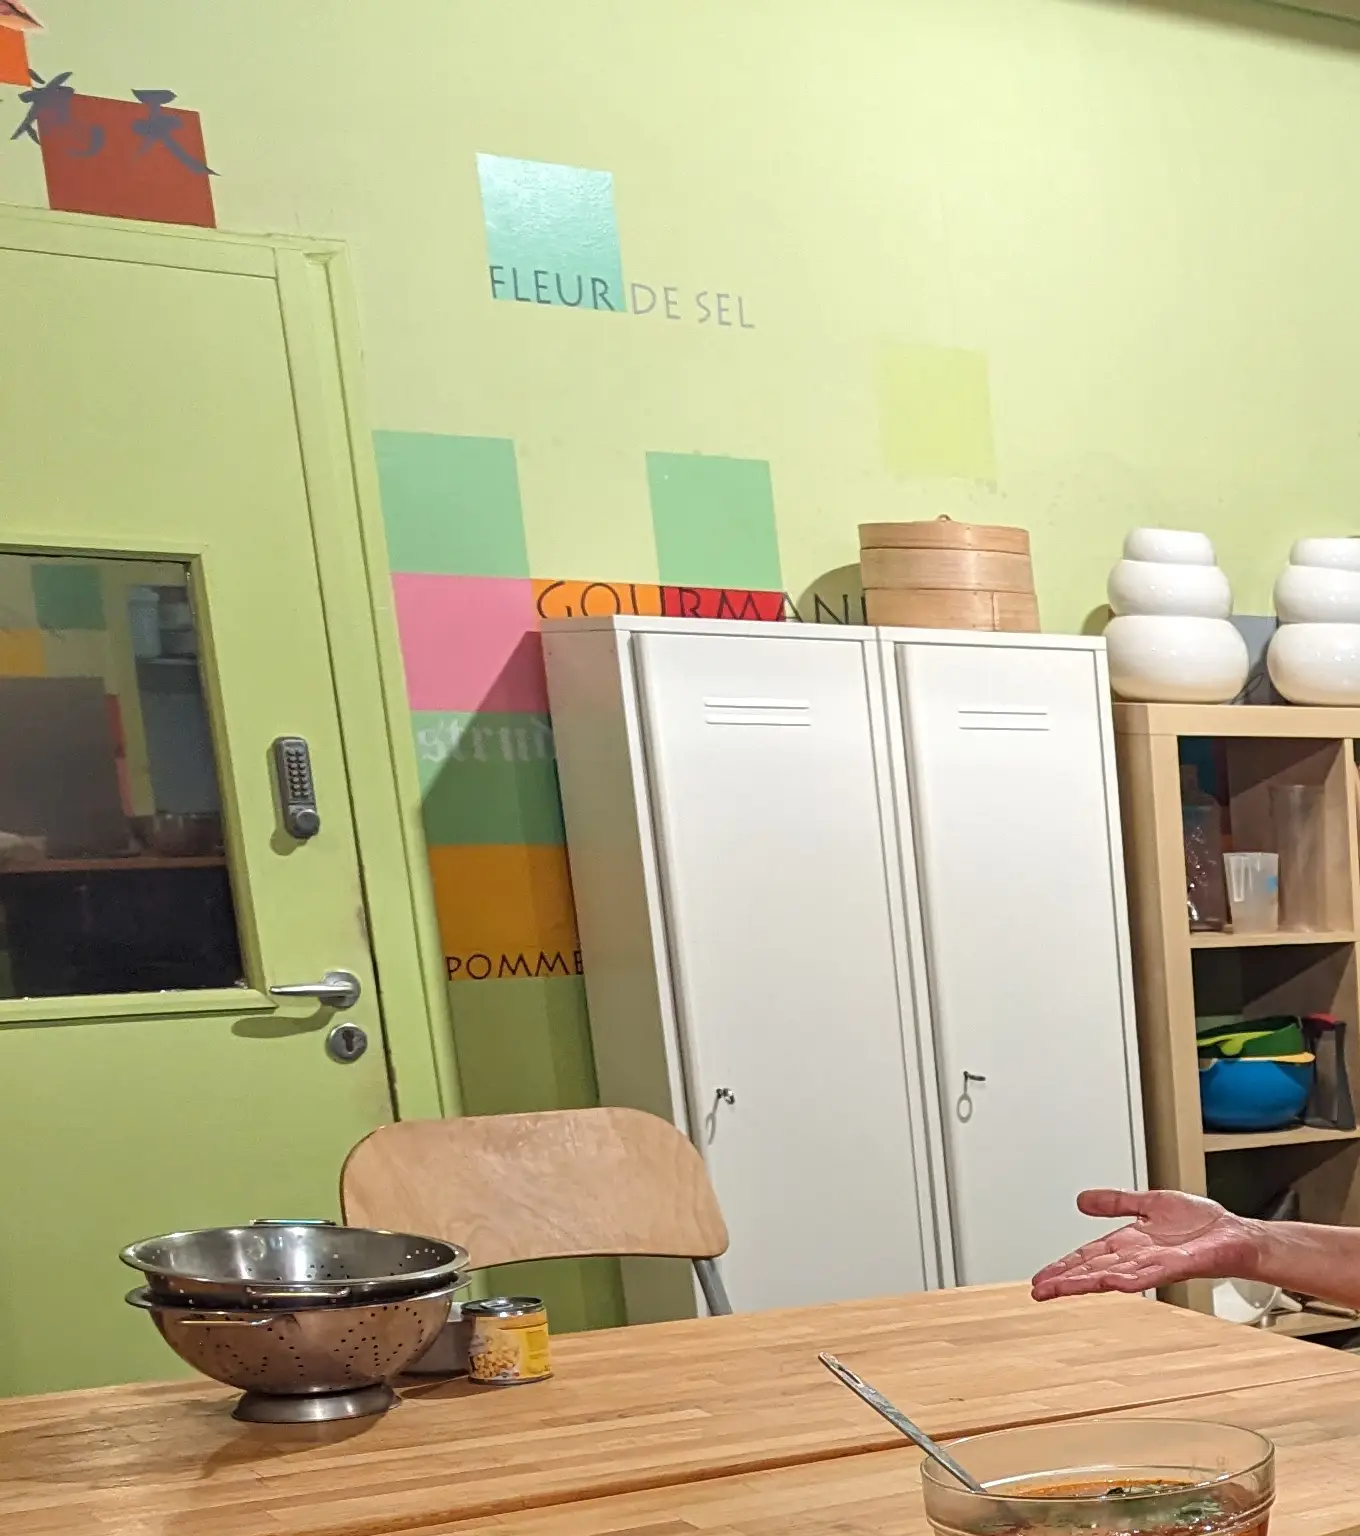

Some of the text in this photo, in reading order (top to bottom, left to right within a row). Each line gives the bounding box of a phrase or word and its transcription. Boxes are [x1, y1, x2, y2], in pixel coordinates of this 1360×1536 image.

[489, 265, 756, 329] FLEUR DE SEL
[537, 581, 868, 625] GOURMAN
